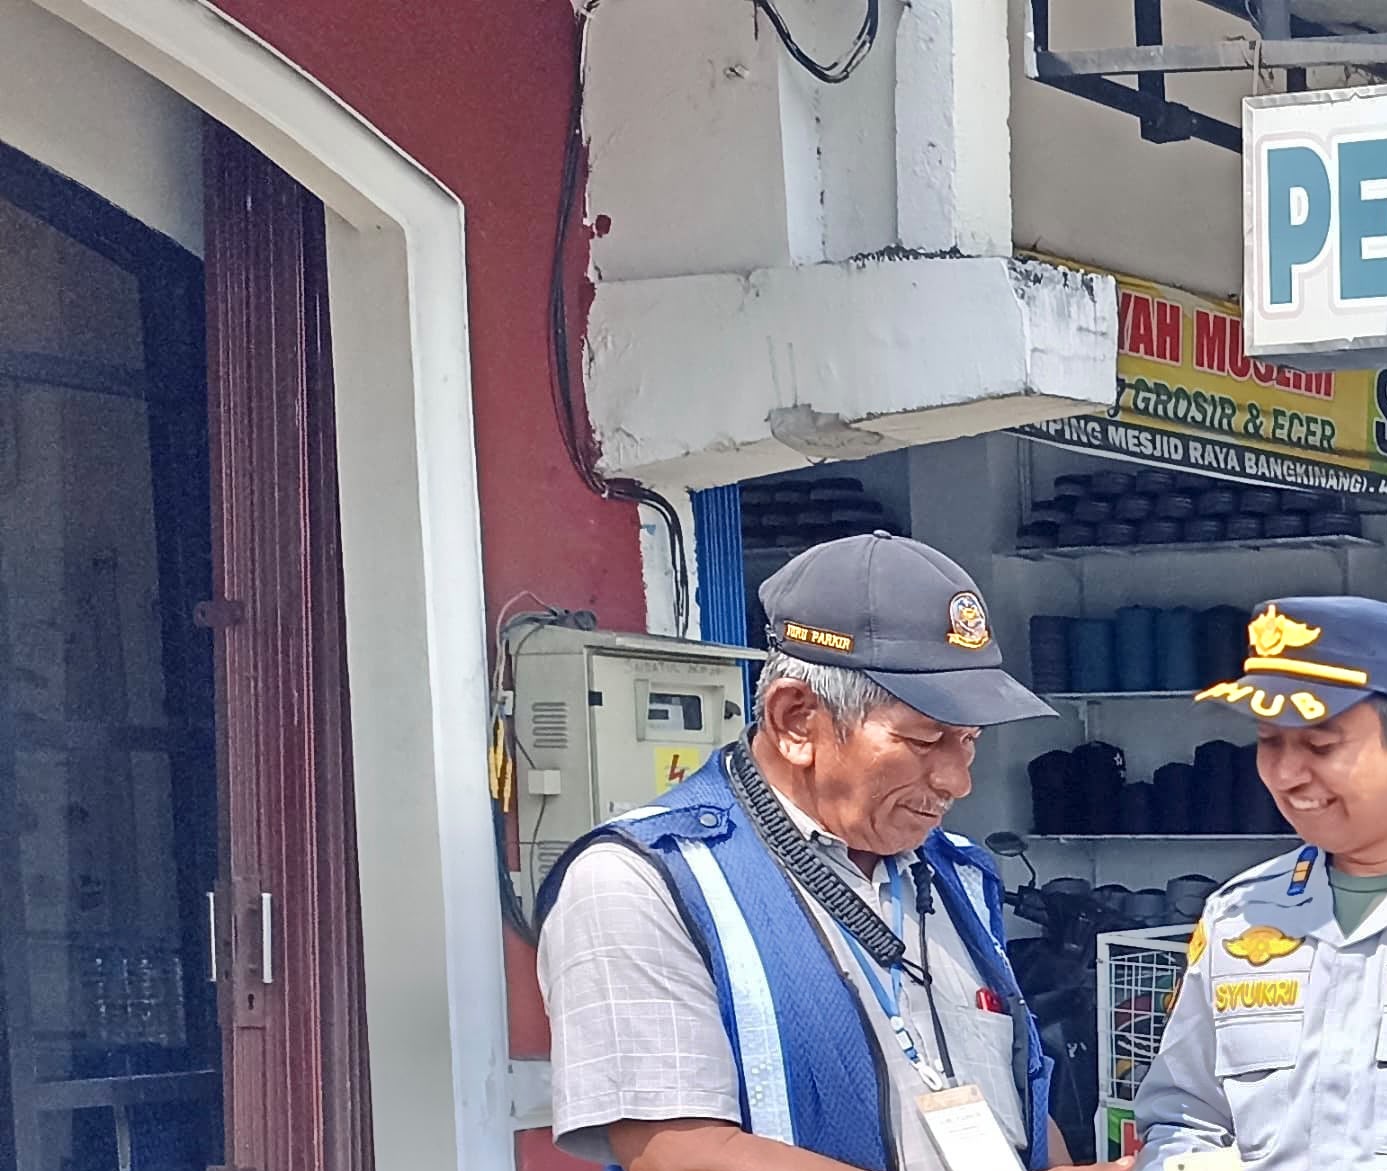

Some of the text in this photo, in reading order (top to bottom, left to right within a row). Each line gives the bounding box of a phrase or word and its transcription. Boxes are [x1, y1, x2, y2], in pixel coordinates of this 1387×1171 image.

[1132, 377, 1237, 435] GROSIR
[1243, 402, 1264, 440] &
[1271, 407, 1337, 451] ECER
[1106, 424, 1184, 461] MESJID
[1188, 441, 1241, 472] RAYA
[811, 629, 852, 651] PARKIR
[1215, 979, 1299, 1013] SYUKRI
